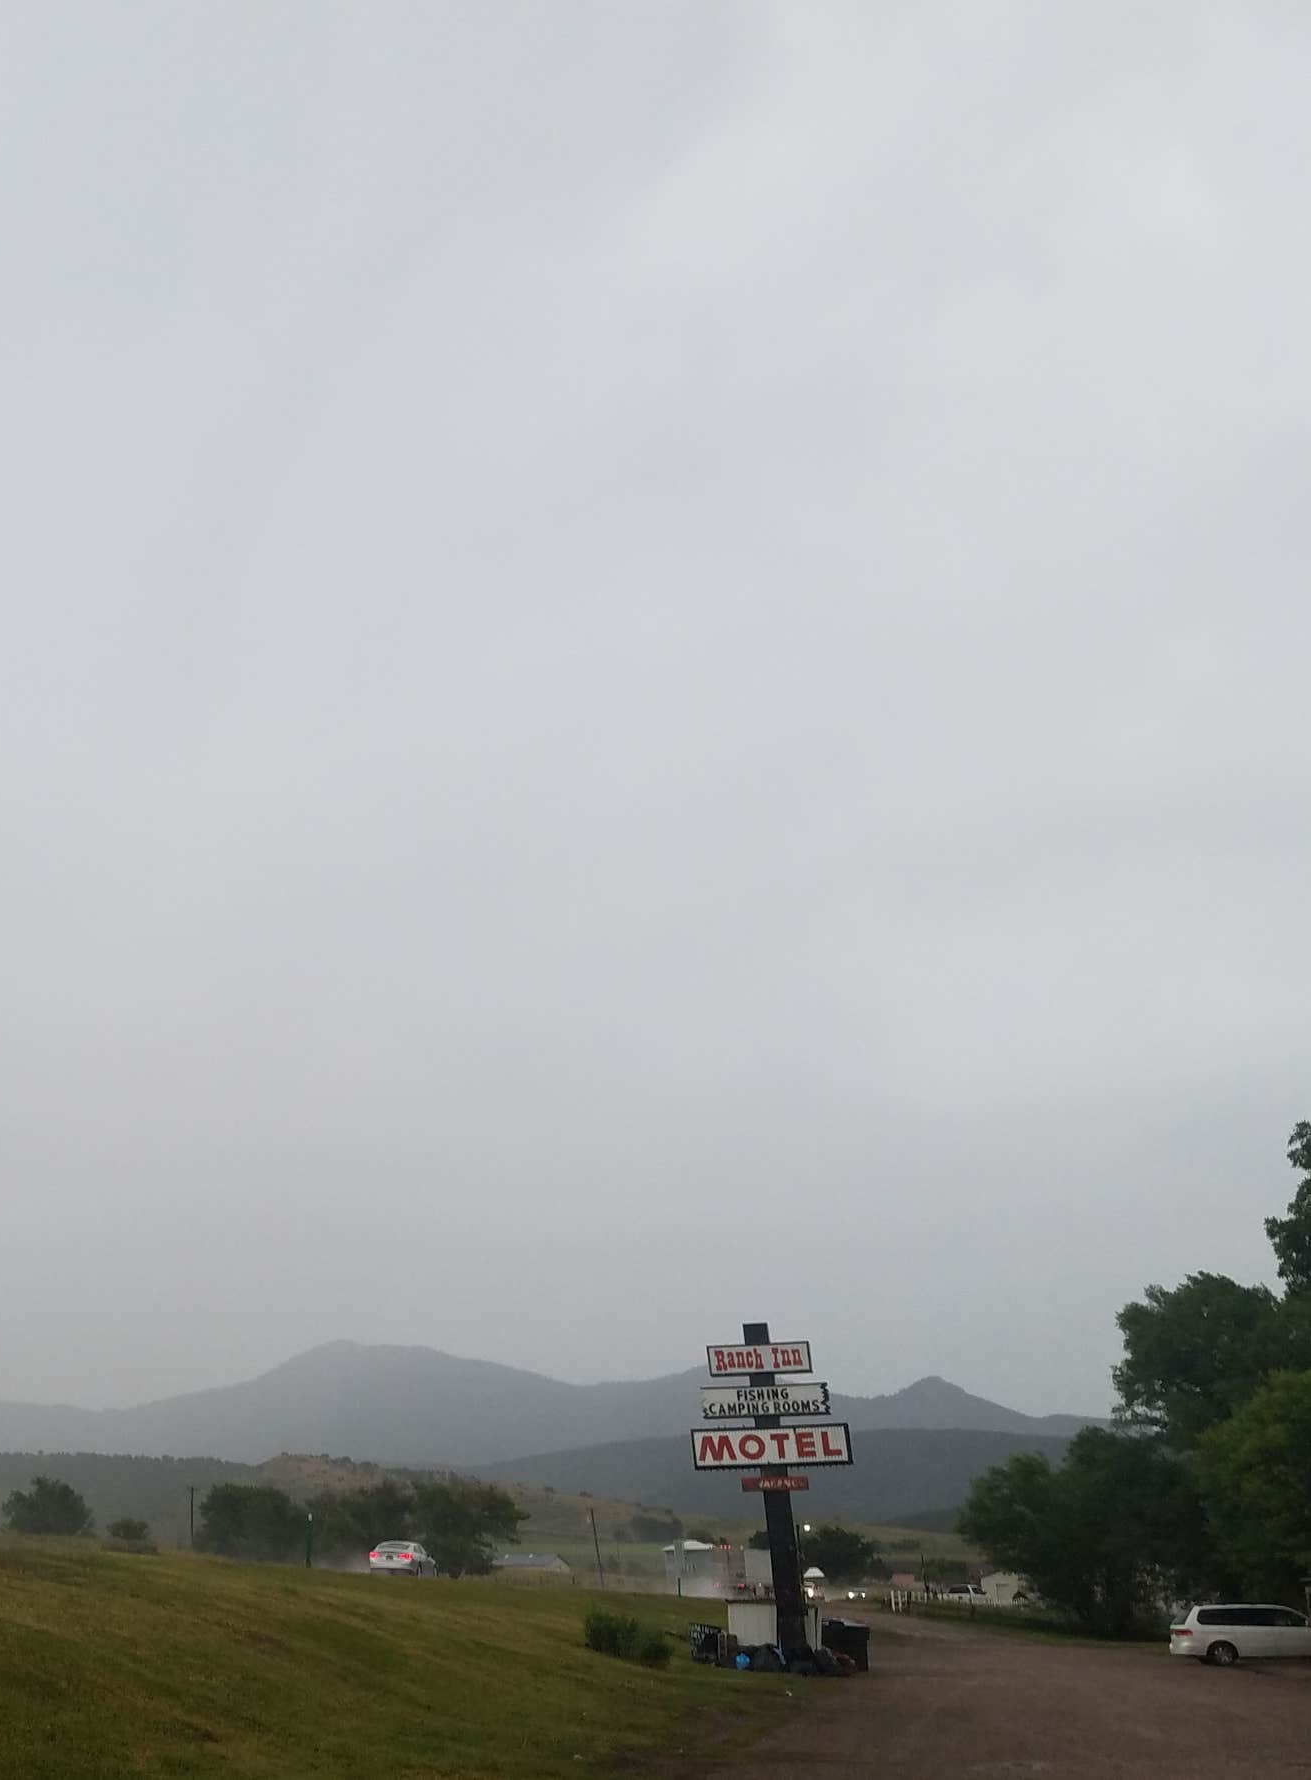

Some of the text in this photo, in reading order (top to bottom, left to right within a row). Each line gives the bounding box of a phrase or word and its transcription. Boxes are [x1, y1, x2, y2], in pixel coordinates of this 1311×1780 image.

[714, 1347, 803, 1371] Ranch Inn
[736, 1388, 789, 1401] FISHING
[708, 1400, 819, 1416] CAMPING ROOMS
[699, 1431, 843, 1461] MOTEL
